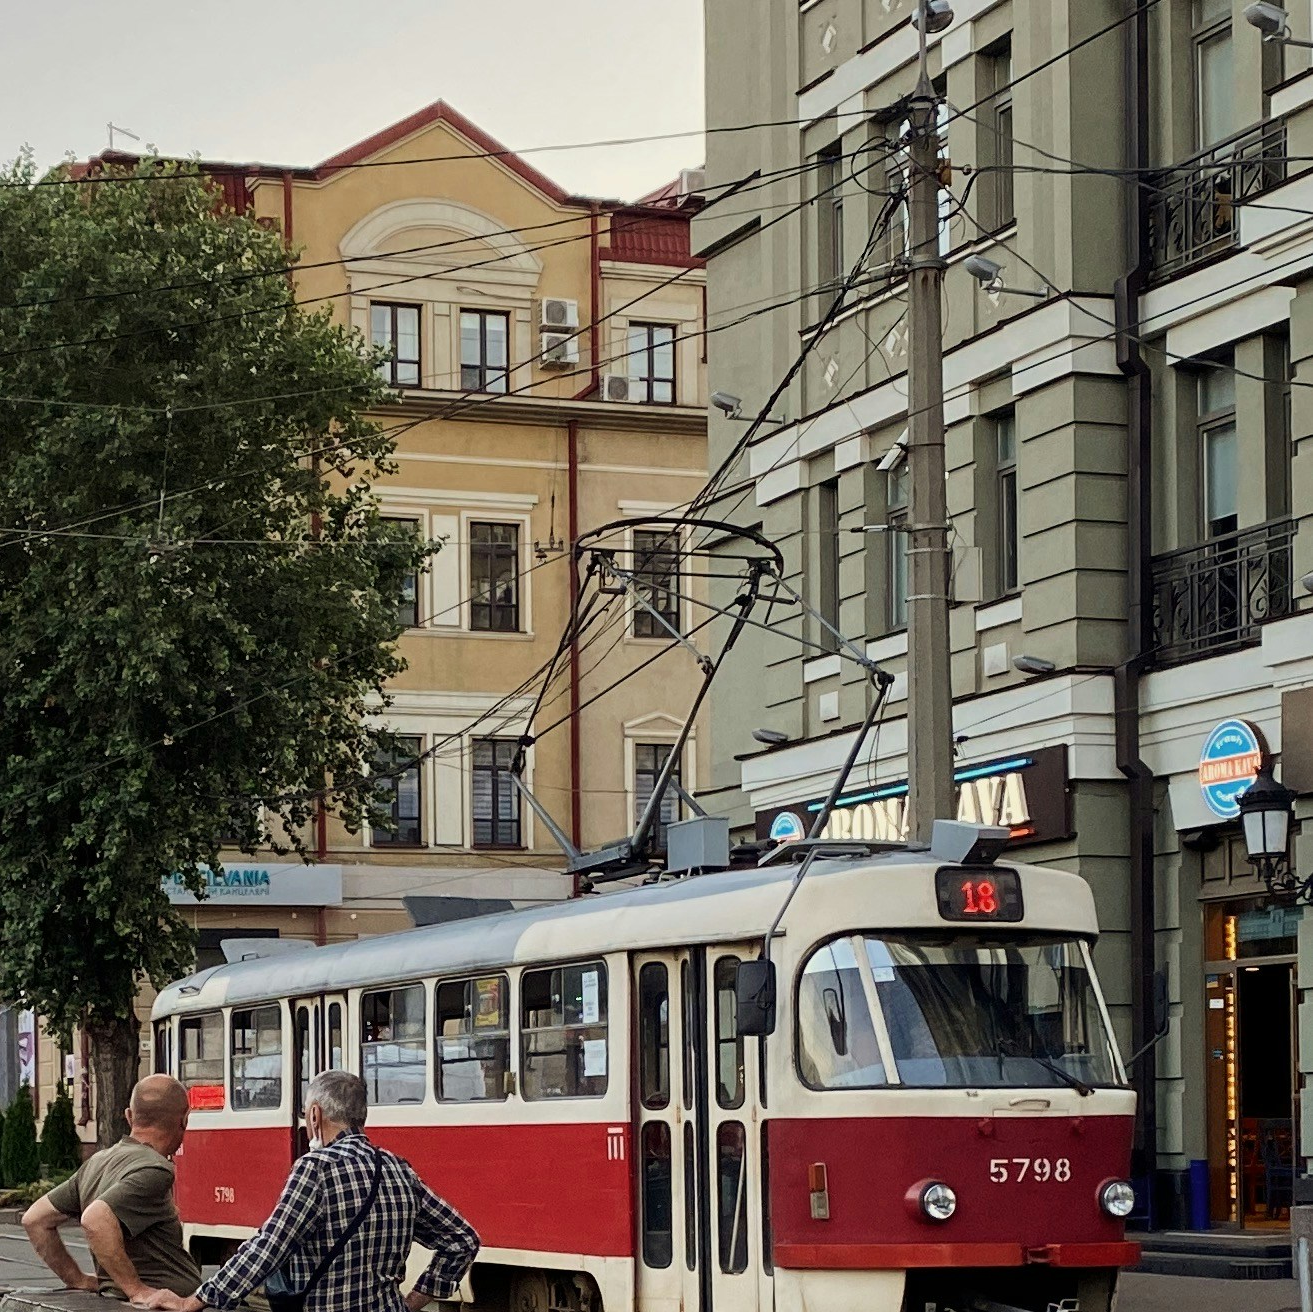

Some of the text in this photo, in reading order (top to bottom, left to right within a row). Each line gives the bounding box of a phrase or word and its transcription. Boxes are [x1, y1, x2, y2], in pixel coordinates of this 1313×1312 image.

[1202, 760, 1233, 780] AROMA
[957, 772, 1031, 826] AVA
[961, 881, 996, 913] 18
[990, 1158, 1071, 1183] 5798
[214, 1186, 235, 1203] 5798
